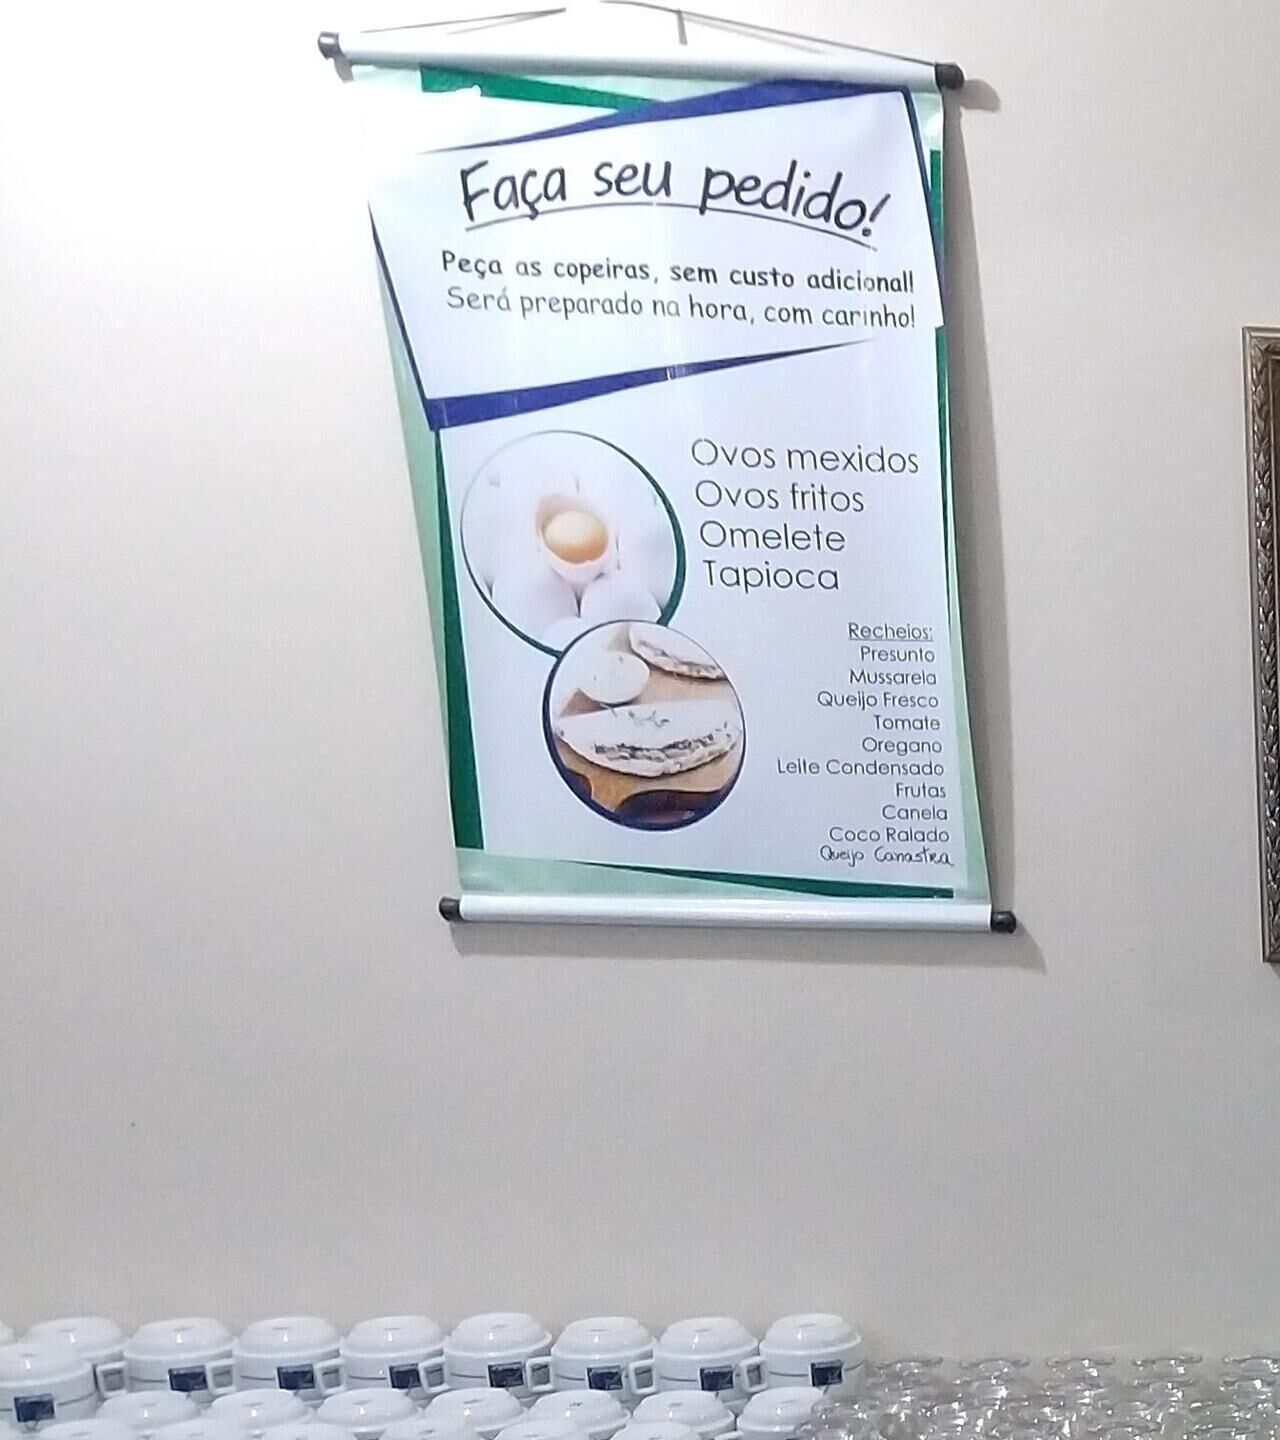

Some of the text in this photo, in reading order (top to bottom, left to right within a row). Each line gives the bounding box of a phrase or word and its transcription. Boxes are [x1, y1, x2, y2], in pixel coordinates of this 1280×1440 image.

[460, 160, 891, 237] Faça seu pedido!
[441, 249, 914, 294] Peça as copeiras, sem custo adicional!
[446, 286, 915, 329] Será preparado na hora, com carinho!
[691, 439, 919, 474] Ovos mexidos
[696, 480, 865, 513] Ovos fritos
[699, 520, 846, 552] Omelete
[703, 559, 839, 593] Tapioca
[848, 623, 934, 641] Recheios:
[860, 646, 935, 663] Presunto
[849, 669, 936, 685] Mussarela
[817, 692, 939, 711] Queijo Fresco
[873, 715, 941, 731] Tomate
[861, 738, 943, 757] Oregano
[777, 759, 944, 776] Leite Condensado
[896, 783, 946, 798] Frutas
[882, 804, 948, 821] Canela
[829, 827, 950, 843] Coco Ralado
[820, 845, 865, 867] Queijo
